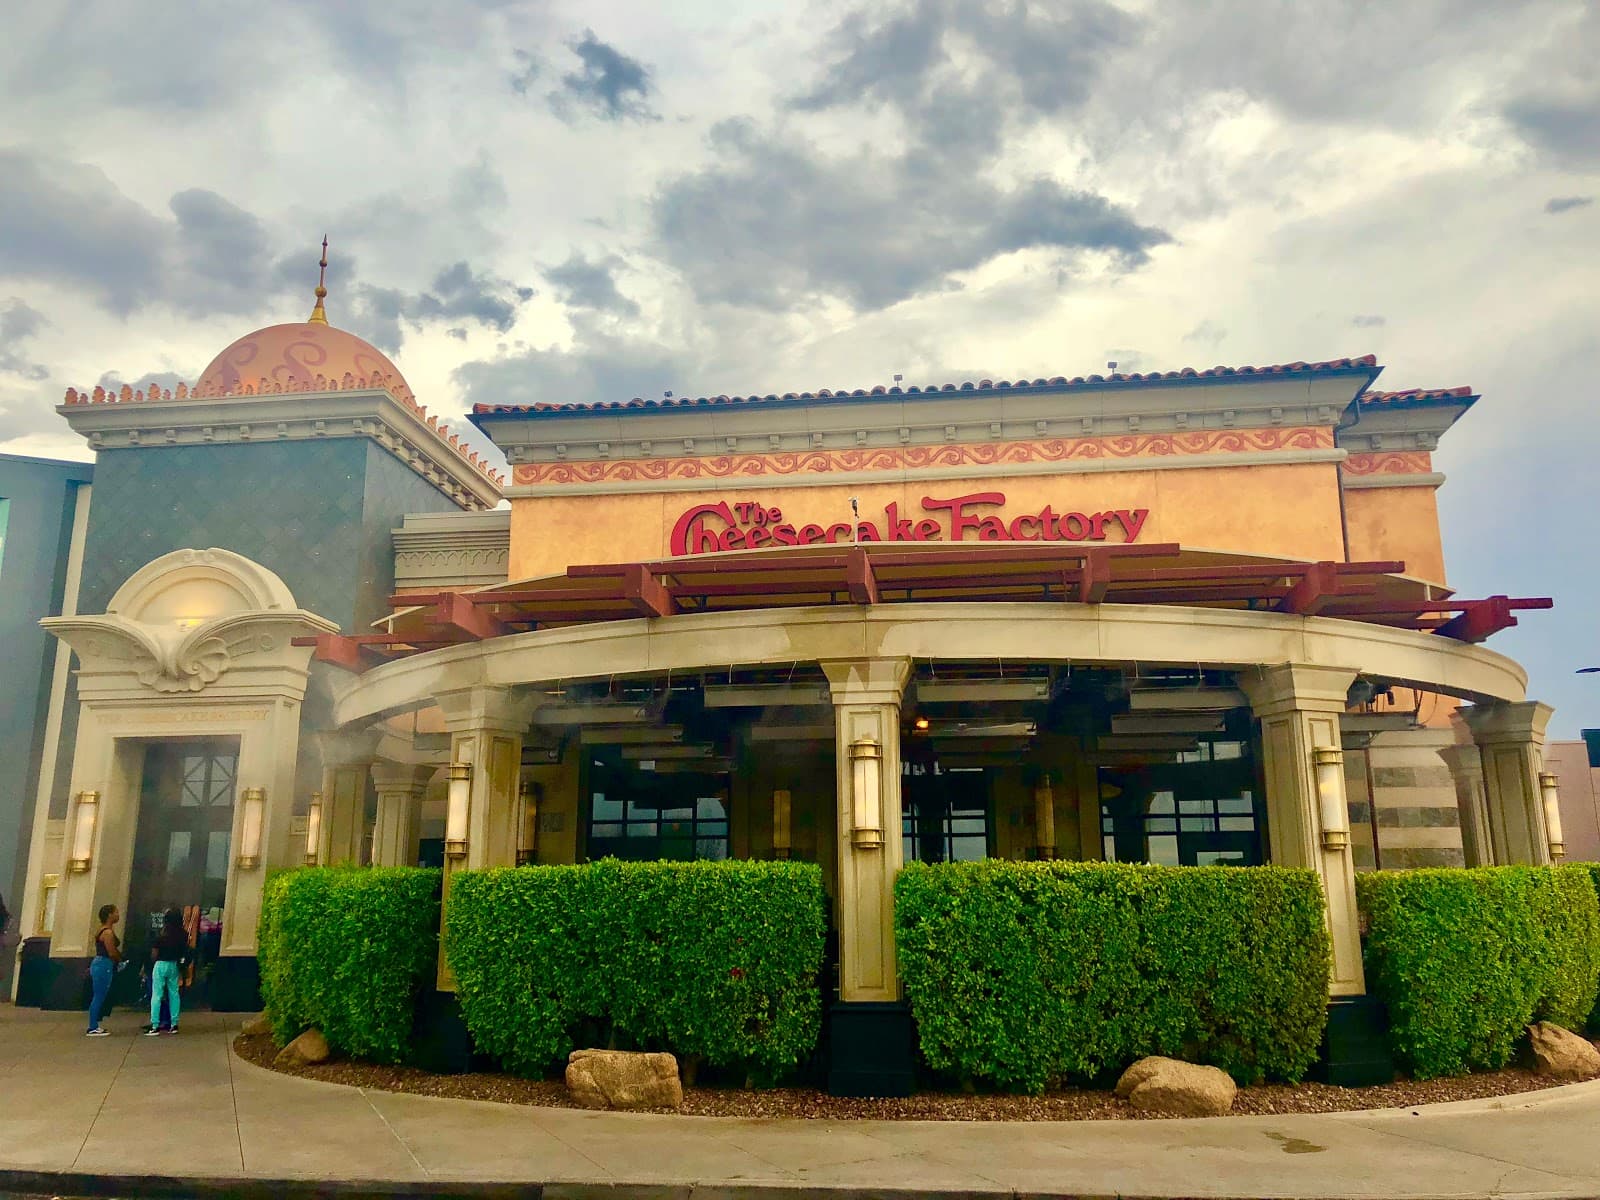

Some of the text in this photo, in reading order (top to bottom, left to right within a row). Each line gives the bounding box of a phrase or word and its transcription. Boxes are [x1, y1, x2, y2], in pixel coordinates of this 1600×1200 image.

[669, 491, 1150, 557] Cheesecake Factory
[734, 500, 782, 528] The
